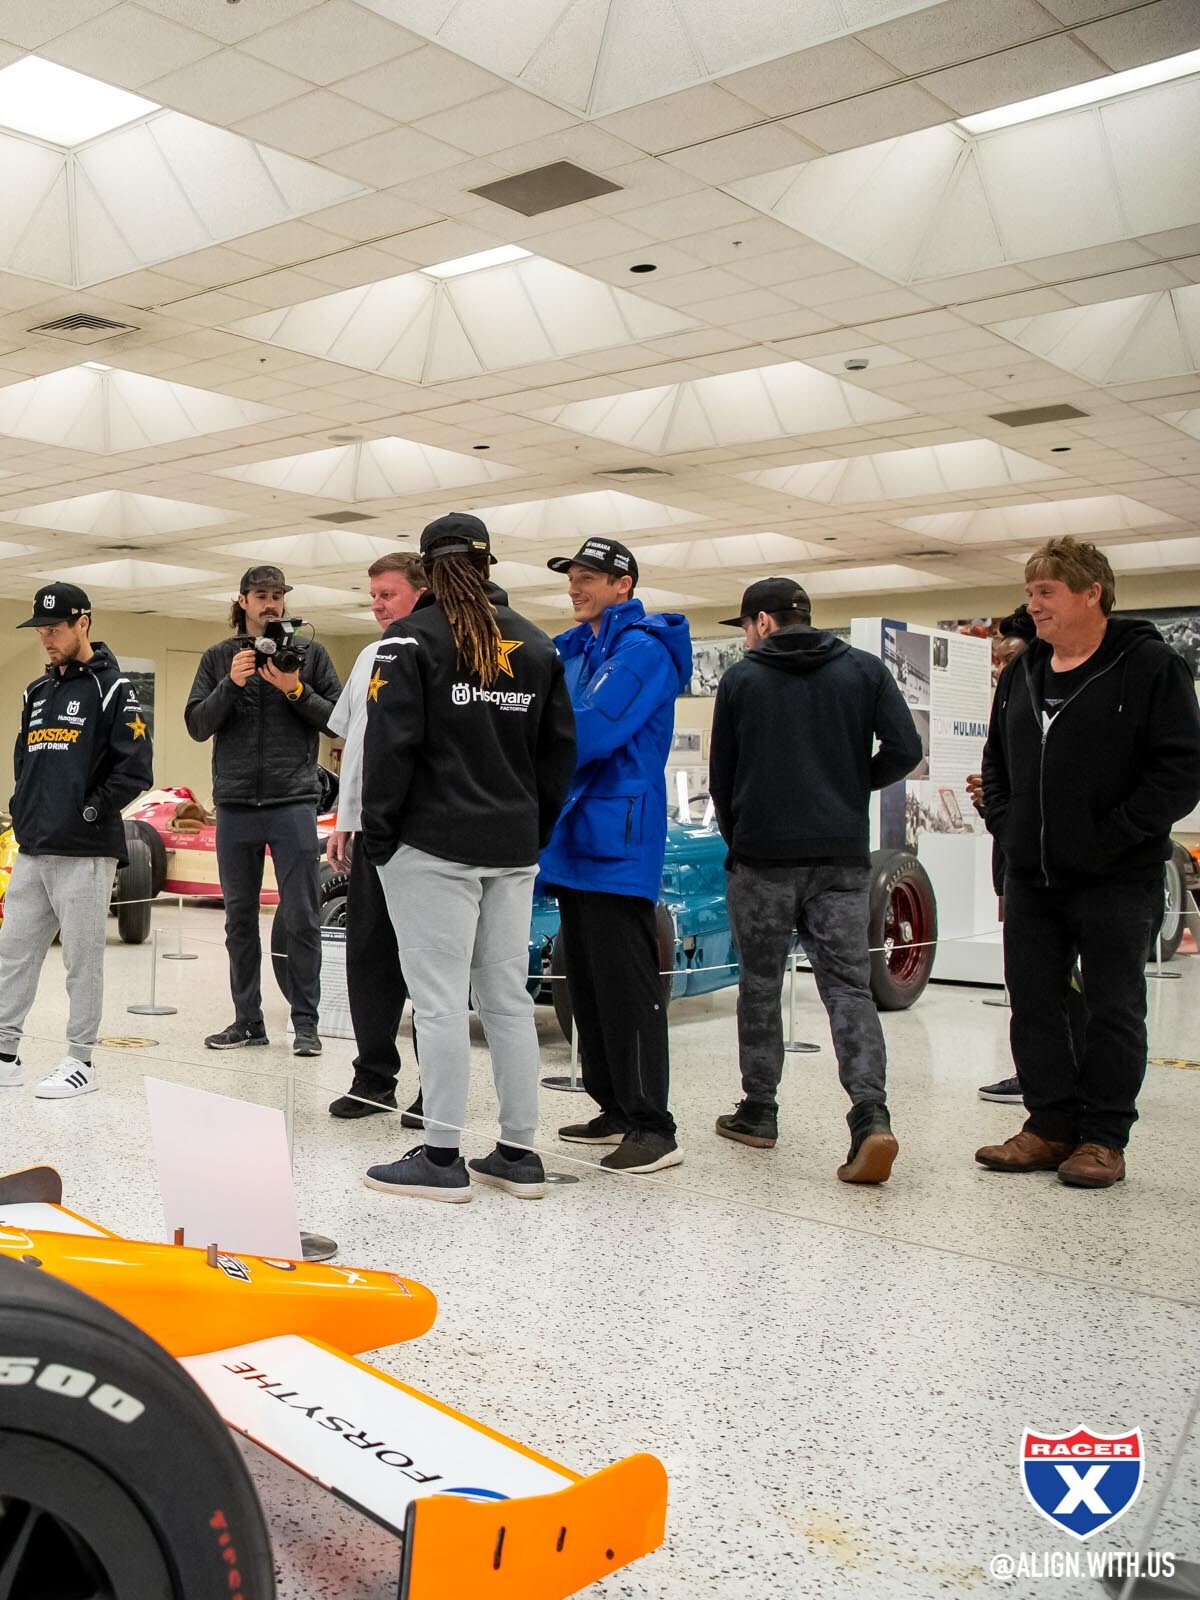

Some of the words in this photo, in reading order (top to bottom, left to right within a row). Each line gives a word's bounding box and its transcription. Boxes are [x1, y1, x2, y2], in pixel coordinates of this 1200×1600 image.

[953, 720, 988, 738] HULMAN
[48, 742, 70, 751] DRINK
[222, 1360, 445, 1484] FORSYTHE
